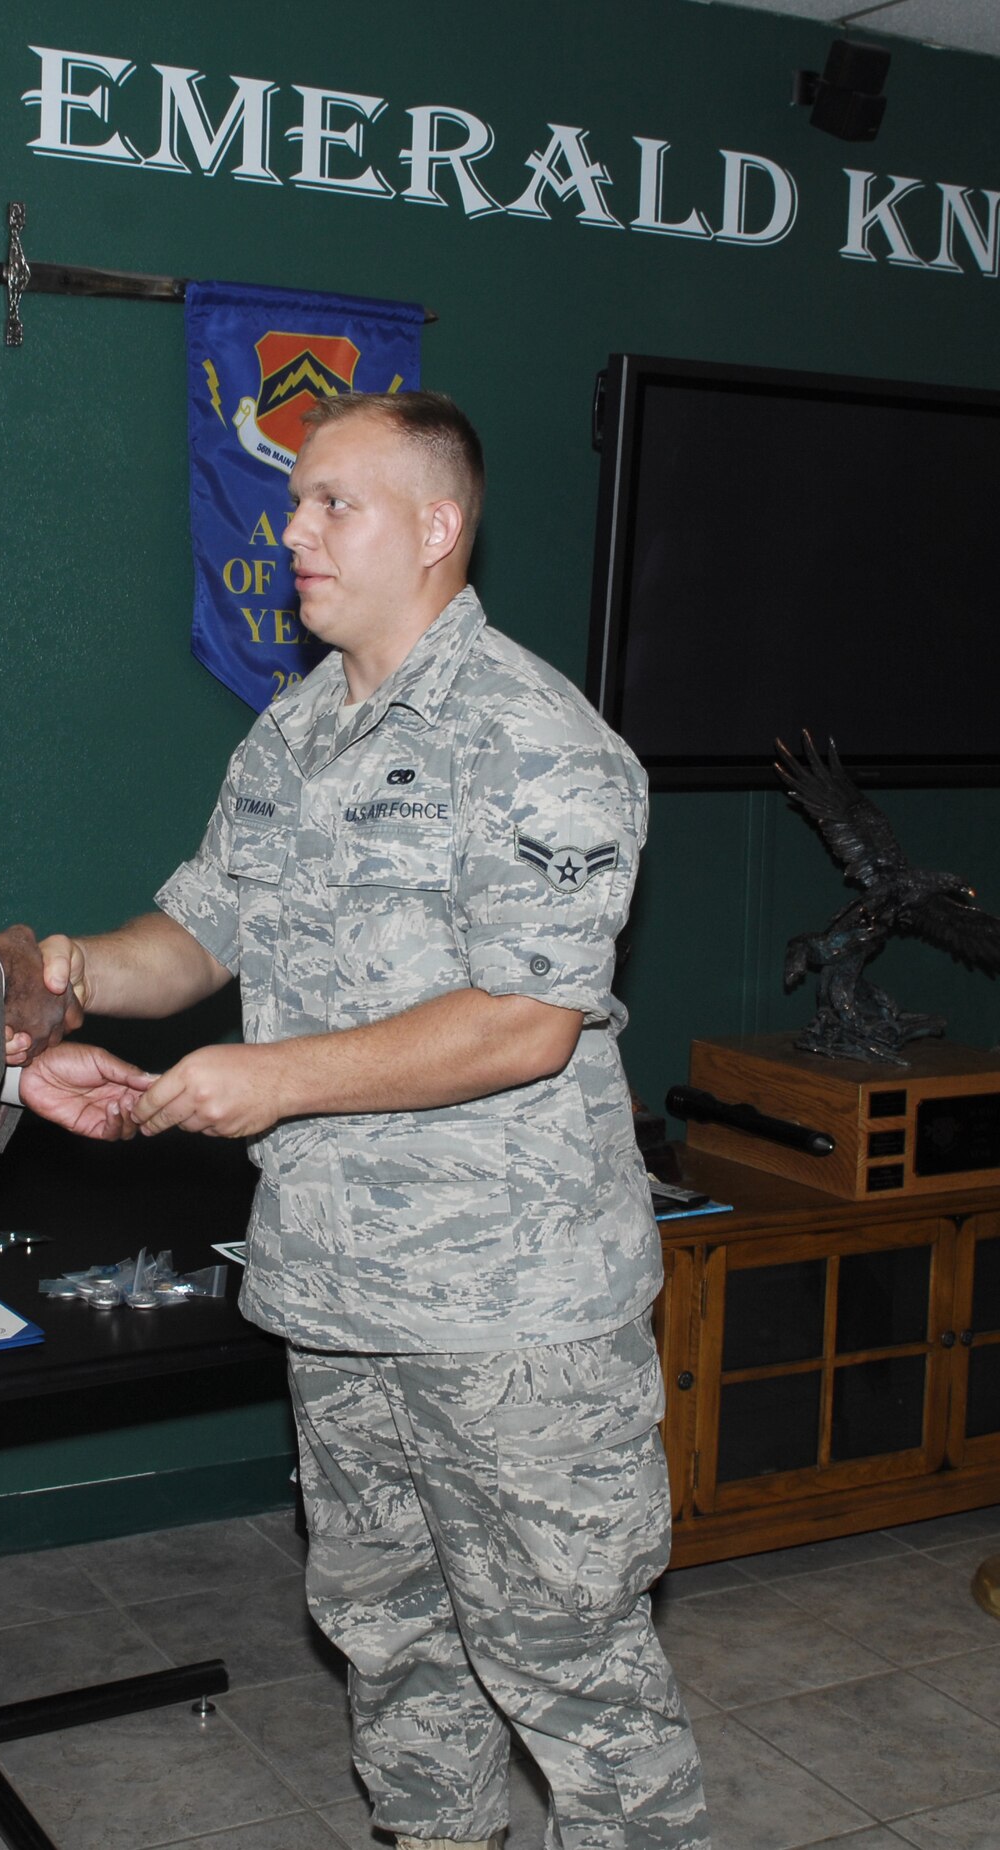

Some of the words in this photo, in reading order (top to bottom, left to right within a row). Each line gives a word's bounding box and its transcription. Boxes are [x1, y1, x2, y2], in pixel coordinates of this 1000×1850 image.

[22, 45, 798, 247] EMERALD
[223, 558, 276, 595] OF
[389, 802, 449, 820] FORCE
